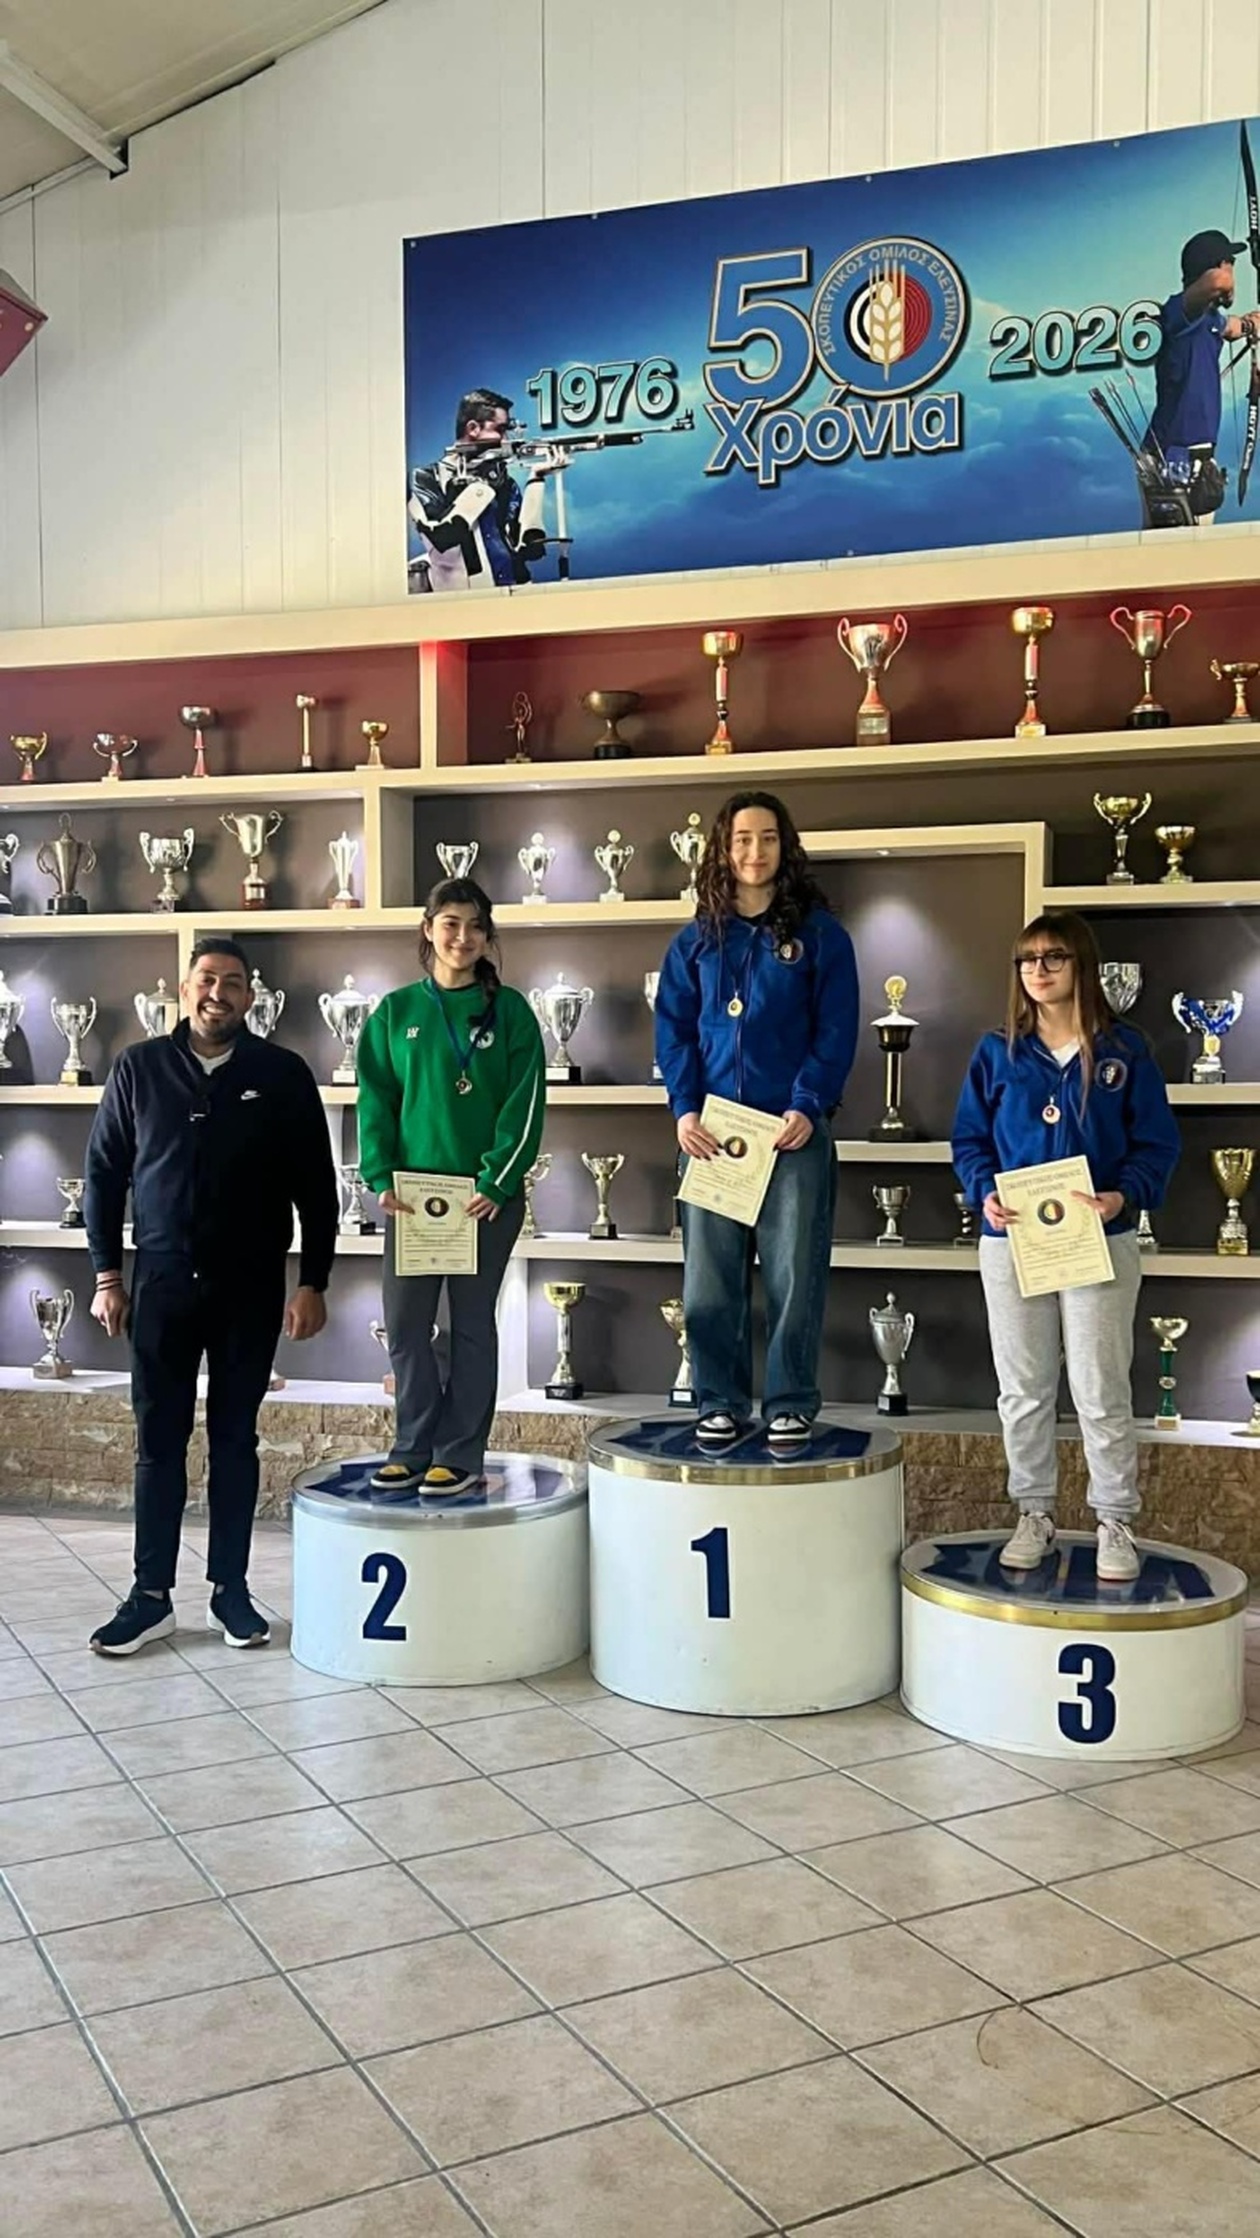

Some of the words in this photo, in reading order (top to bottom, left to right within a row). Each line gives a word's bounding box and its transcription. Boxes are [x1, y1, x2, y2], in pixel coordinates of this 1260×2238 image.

[703, 235, 967, 411] 50
[818, 253, 869, 357] ΣΚΟΠΕΥΤΙΚΟΣ
[868, 244, 930, 266] ΟΜΙΛΟΣ
[926, 260, 958, 342] ΕΛΕΥΣΙΝΑΣ
[990, 300, 1164, 378] 2026
[526, 356, 680, 428] 1976
[361, 1552, 408, 1642] 2
[691, 1527, 731, 1619] 1
[1058, 1643, 1117, 1744] 3
